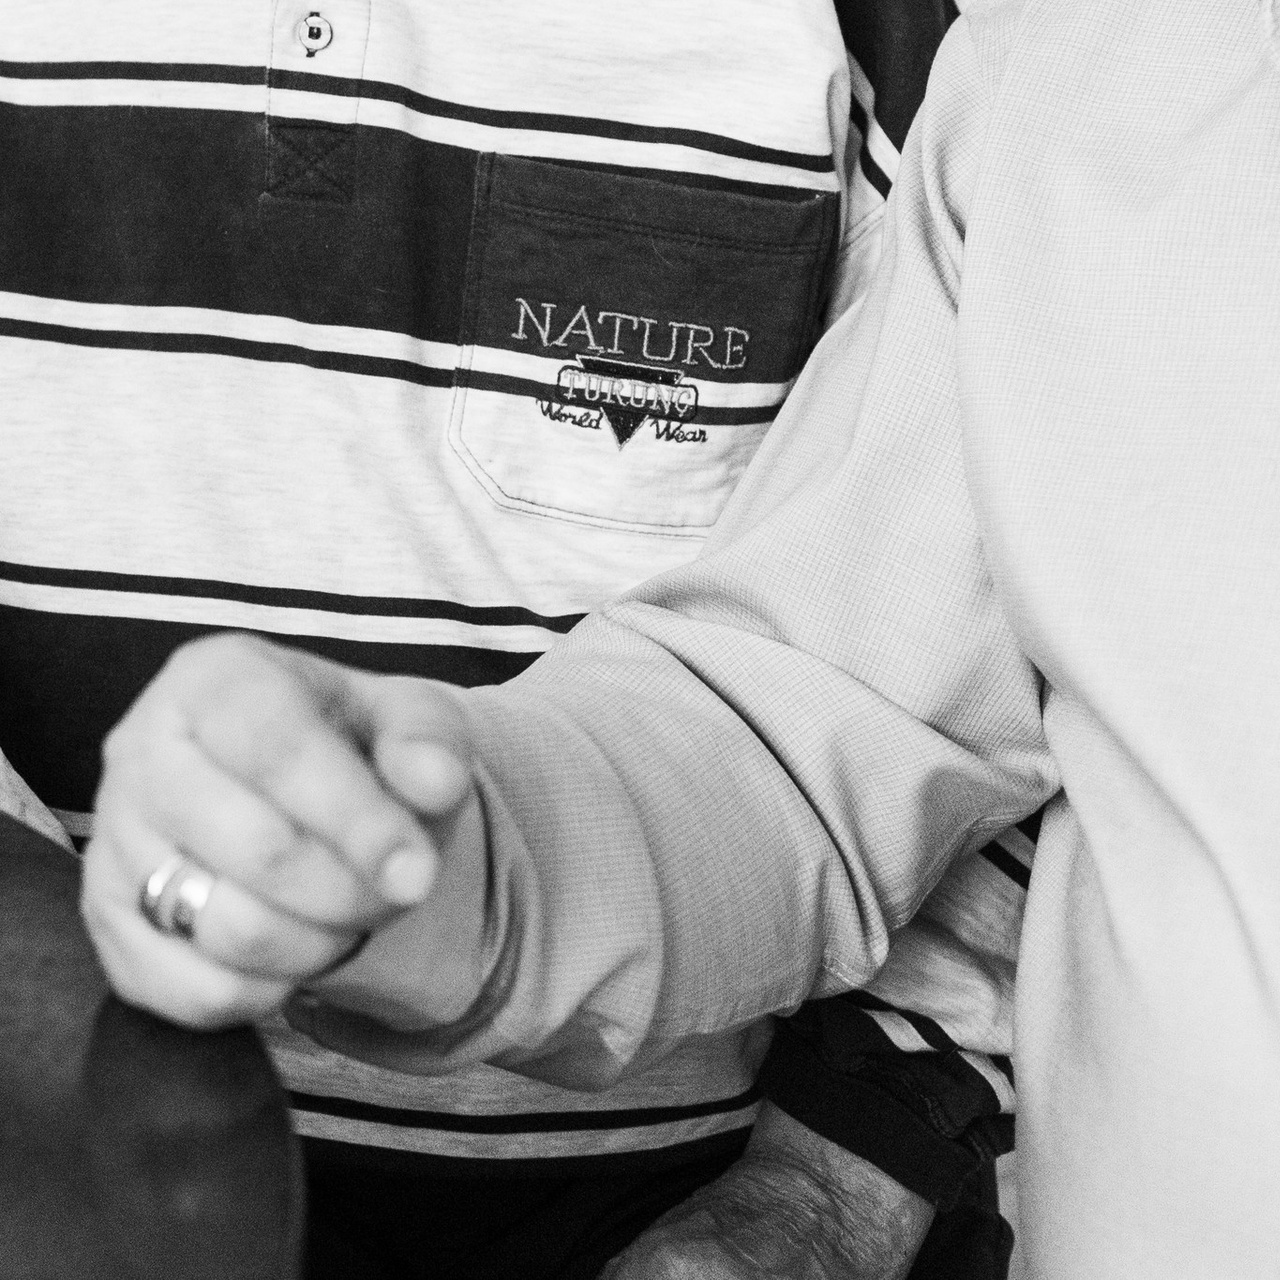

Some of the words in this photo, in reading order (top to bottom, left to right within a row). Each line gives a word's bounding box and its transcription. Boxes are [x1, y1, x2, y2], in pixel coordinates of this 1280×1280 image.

[511, 297, 750, 370] NATURE
[535, 398, 603, 429] World
[649, 418, 709, 443] Wear
